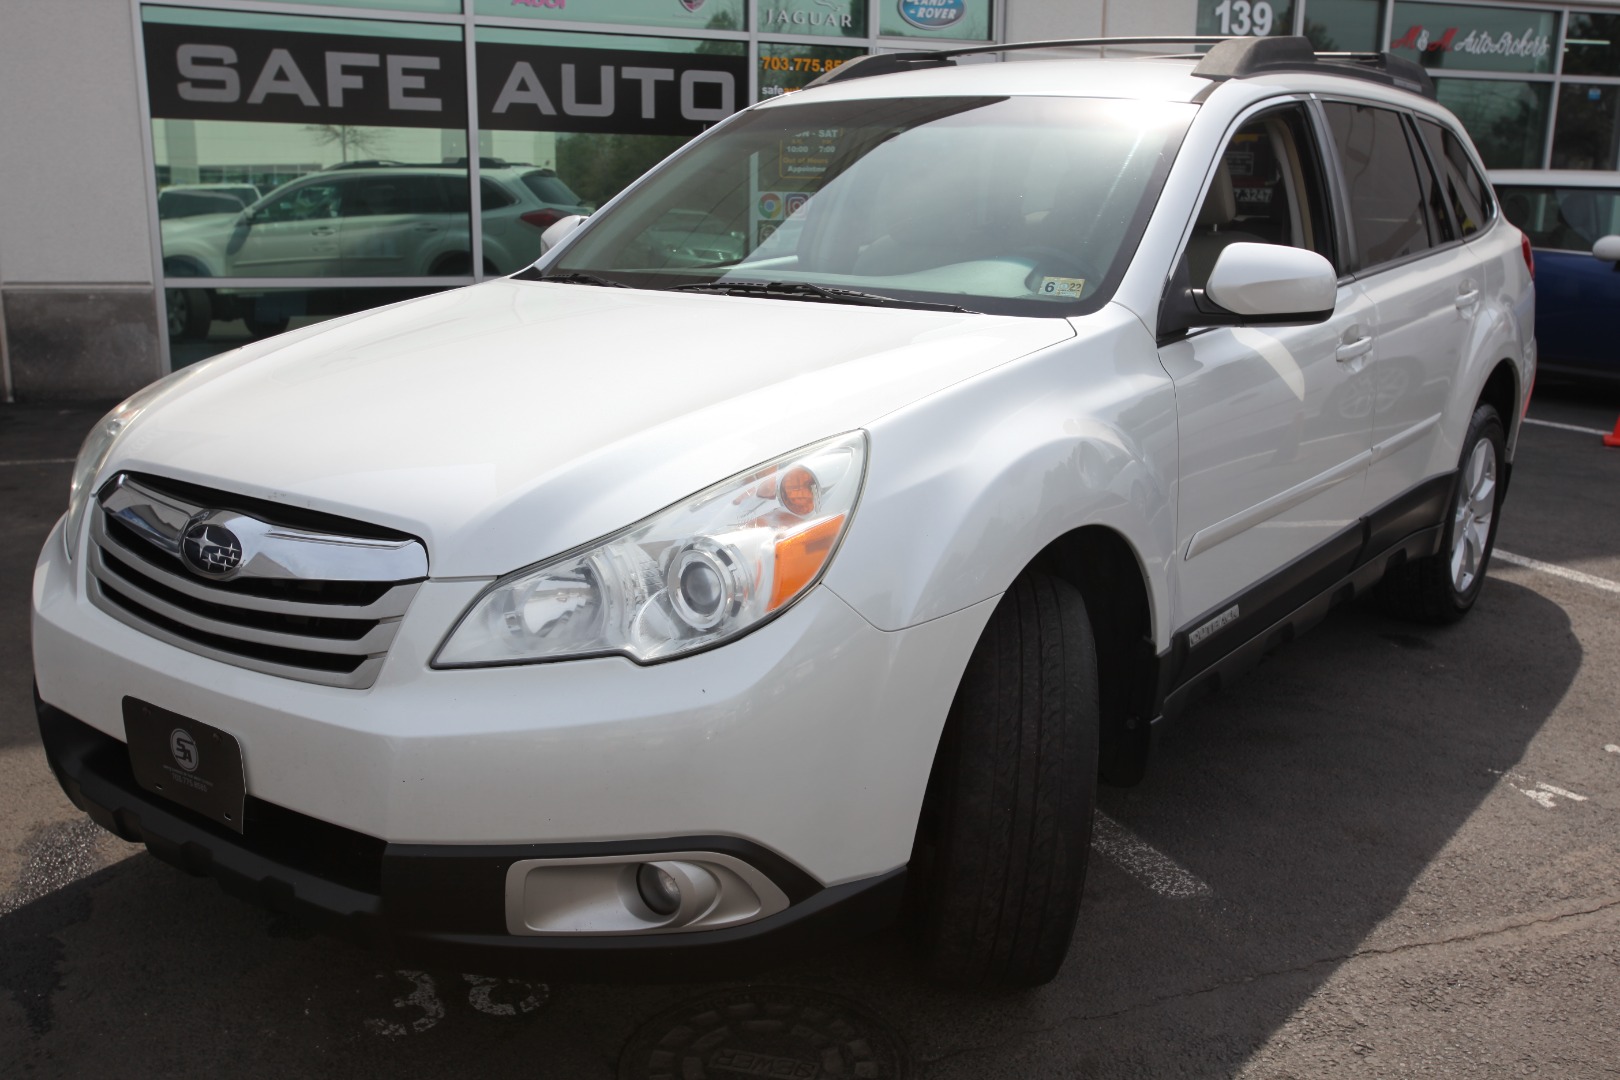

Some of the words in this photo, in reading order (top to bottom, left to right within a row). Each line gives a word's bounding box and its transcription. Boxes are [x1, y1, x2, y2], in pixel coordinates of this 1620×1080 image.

[766, 8, 852, 28] JAGUAR
[917, 7, 957, 19] ROVER
[1215, 0, 1273, 36] 139
[1416, 29, 1430, 51] &
[176, 43, 443, 112] SAFE
[491, 60, 735, 121] AUTO
[1044, 281, 1056, 293] 6
[1069, 282, 1082, 292] 22
